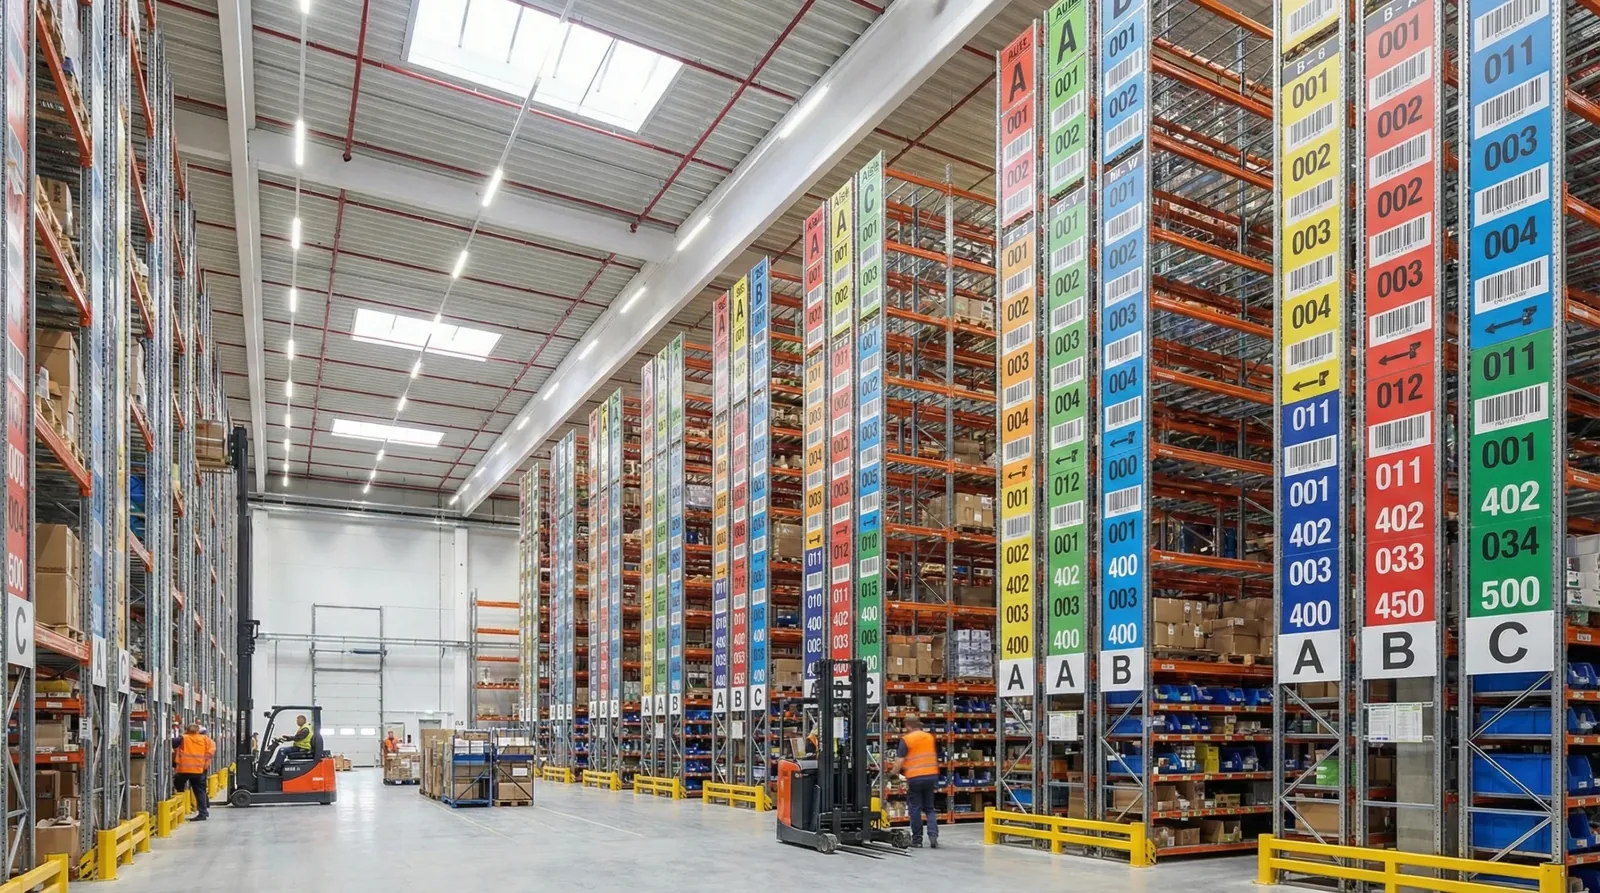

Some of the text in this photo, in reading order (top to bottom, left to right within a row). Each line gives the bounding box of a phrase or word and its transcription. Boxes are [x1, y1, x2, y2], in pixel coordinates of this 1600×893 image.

[1057, 19, 1077, 65] A
[1110, 24, 1135, 57] 001
[1378, 14, 1420, 58] 001
[1484, 36, 1533, 84] 011
[1008, 62, 1026, 104] A
[1056, 65, 1078, 98] 001
[1292, 68, 1327, 108] 001
[1110, 84, 1137, 118] 002
[1008, 105, 1027, 134] 001
[1377, 95, 1423, 138] 002
[1056, 124, 1080, 155] 002
[1484, 125, 1537, 171] 003
[1008, 160, 1029, 188] 002
[1292, 143, 1331, 182] 002
[865, 184, 874, 213] C
[1110, 177, 1135, 207] 001
[1377, 177, 1423, 218] 002
[837, 209, 847, 238] A
[863, 220, 877, 242] 001
[1056, 211, 1078, 239] 001
[811, 233, 819, 259] A
[1292, 219, 1331, 255] 003
[1484, 216, 1538, 260] 004
[835, 243, 847, 263] 001
[1008, 241, 1027, 267] 001
[1109, 239, 1137, 269] 002
[863, 266, 877, 286] 003
[1056, 269, 1080, 296] 002
[1377, 259, 1423, 297] 003
[756, 283, 762, 305] B
[835, 286, 848, 305] 002
[737, 299, 743, 322] A
[1008, 296, 1029, 321] 002
[1109, 303, 1136, 331] 003
[1292, 294, 1331, 329] 004
[863, 331, 876, 351] 001
[1055, 330, 1080, 356] 003
[1008, 352, 1029, 376] 003
[1483, 341, 1535, 381] 011
[862, 376, 877, 396] 002
[1109, 366, 1137, 394] 004
[1377, 373, 1423, 409] 012
[1055, 389, 1080, 414] 004
[1007, 408, 1029, 432] 004
[1293, 399, 1329, 431] 011
[862, 421, 877, 441] 003
[1482, 432, 1535, 469] 001
[1109, 455, 1137, 480] 000
[1375, 456, 1421, 491] 011
[834, 480, 848, 498] 003
[1055, 472, 1080, 496] 012
[1290, 476, 1329, 507] 001
[1007, 487, 1027, 508] 001
[1481, 481, 1540, 516] 402
[1375, 501, 1424, 533] 402
[1055, 532, 1078, 555] 001
[1109, 519, 1135, 544] 001
[1290, 518, 1332, 547] 402
[1482, 526, 1539, 561] 034
[809, 551, 821, 566] 011
[834, 542, 848, 559] 012
[1006, 544, 1029, 565] 002
[1375, 543, 1424, 574] 033
[1054, 565, 1080, 587] 402
[1108, 554, 1138, 578] 400
[1289, 557, 1332, 586] 003
[834, 587, 847, 603] 011
[862, 581, 877, 597] 015
[1006, 574, 1029, 594] 402
[1482, 576, 1540, 610] 500
[808, 594, 821, 608] 010
[1054, 596, 1079, 617] 003
[1109, 587, 1137, 610] 003
[1375, 589, 1424, 619] 450
[808, 617, 821, 631] 400
[834, 611, 848, 626] 402
[862, 606, 877, 621] 400
[1006, 605, 1029, 623] 003
[1289, 601, 1332, 627] 400
[16, 606, 26, 655] C
[862, 630, 877, 644] 003
[1054, 629, 1080, 649] 400
[1108, 622, 1137, 645] 400
[1489, 621, 1528, 664] C
[1006, 635, 1028, 654] 400
[1293, 639, 1324, 675] A
[1382, 631, 1415, 670] B
[96, 641, 102, 678] A
[121, 654, 126, 685] C
[863, 655, 877, 672] 00
[1113, 655, 1131, 684] B
[1008, 664, 1024, 690] A
[1056, 660, 1075, 688] A
[644, 698, 649, 713] A
[658, 698, 663, 712] A
[673, 696, 677, 710] B
[717, 692, 724, 709] A
[735, 691, 741, 707] B
[755, 688, 761, 706] C
